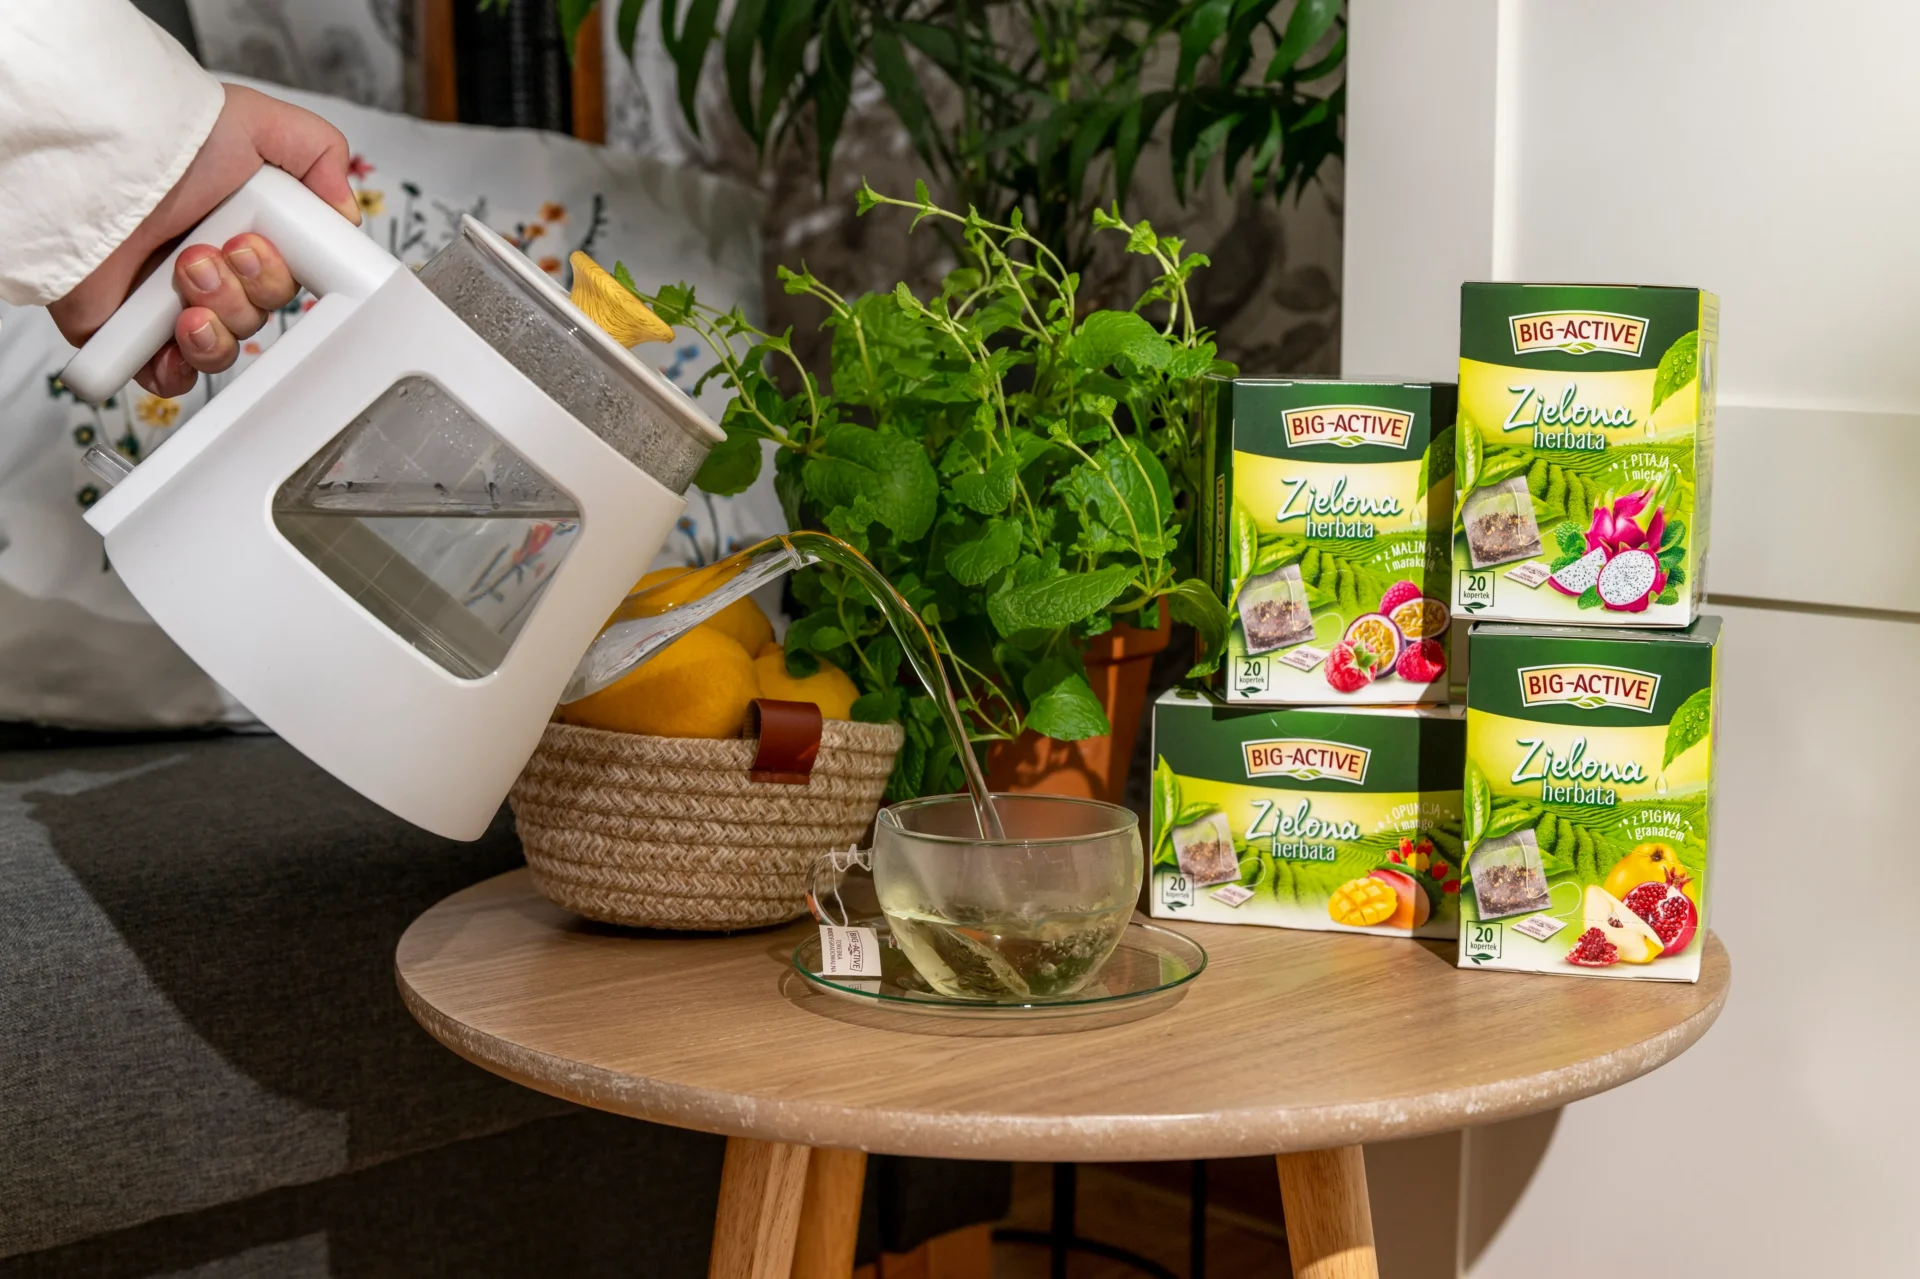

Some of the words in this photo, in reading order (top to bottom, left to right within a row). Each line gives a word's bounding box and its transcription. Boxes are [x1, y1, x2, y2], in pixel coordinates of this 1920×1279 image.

[1519, 320, 1638, 345] BIG-ACTIVE
[1502, 381, 1637, 432] Zielona
[1291, 414, 1404, 437] BIG-ACTIVE
[1533, 425, 1606, 450] herbata
[1631, 453, 1669, 471] PITAJĄ
[1276, 473, 1403, 522] Zielona
[1306, 515, 1374, 539] herbata
[1391, 541, 1432, 557] MALINĄ
[1392, 555, 1435, 572] marakują
[1468, 575, 1486, 592] 20
[1463, 590, 1490, 600] kopertek
[1243, 661, 1261, 676] 20
[1239, 674, 1265, 684] kopertek
[1528, 673, 1649, 701] BIG-ACTIVE
[1251, 747, 1361, 773] BIG-ACTIVE
[1511, 736, 1648, 784] Zielona
[1542, 779, 1615, 806] herbata
[1245, 798, 1361, 841] Zielona
[1391, 802, 1441, 819] OPUNCJĄ
[1641, 809, 1681, 829] PIGWĄ
[1401, 818, 1434, 831] mango
[1635, 826, 1685, 842] granatem
[1272, 837, 1335, 861] herbata
[1170, 876, 1186, 891] 20
[1474, 926, 1493, 943] 20
[849, 932, 860, 969] BIG-ACTIVE
[1470, 942, 1498, 952] kopertek
